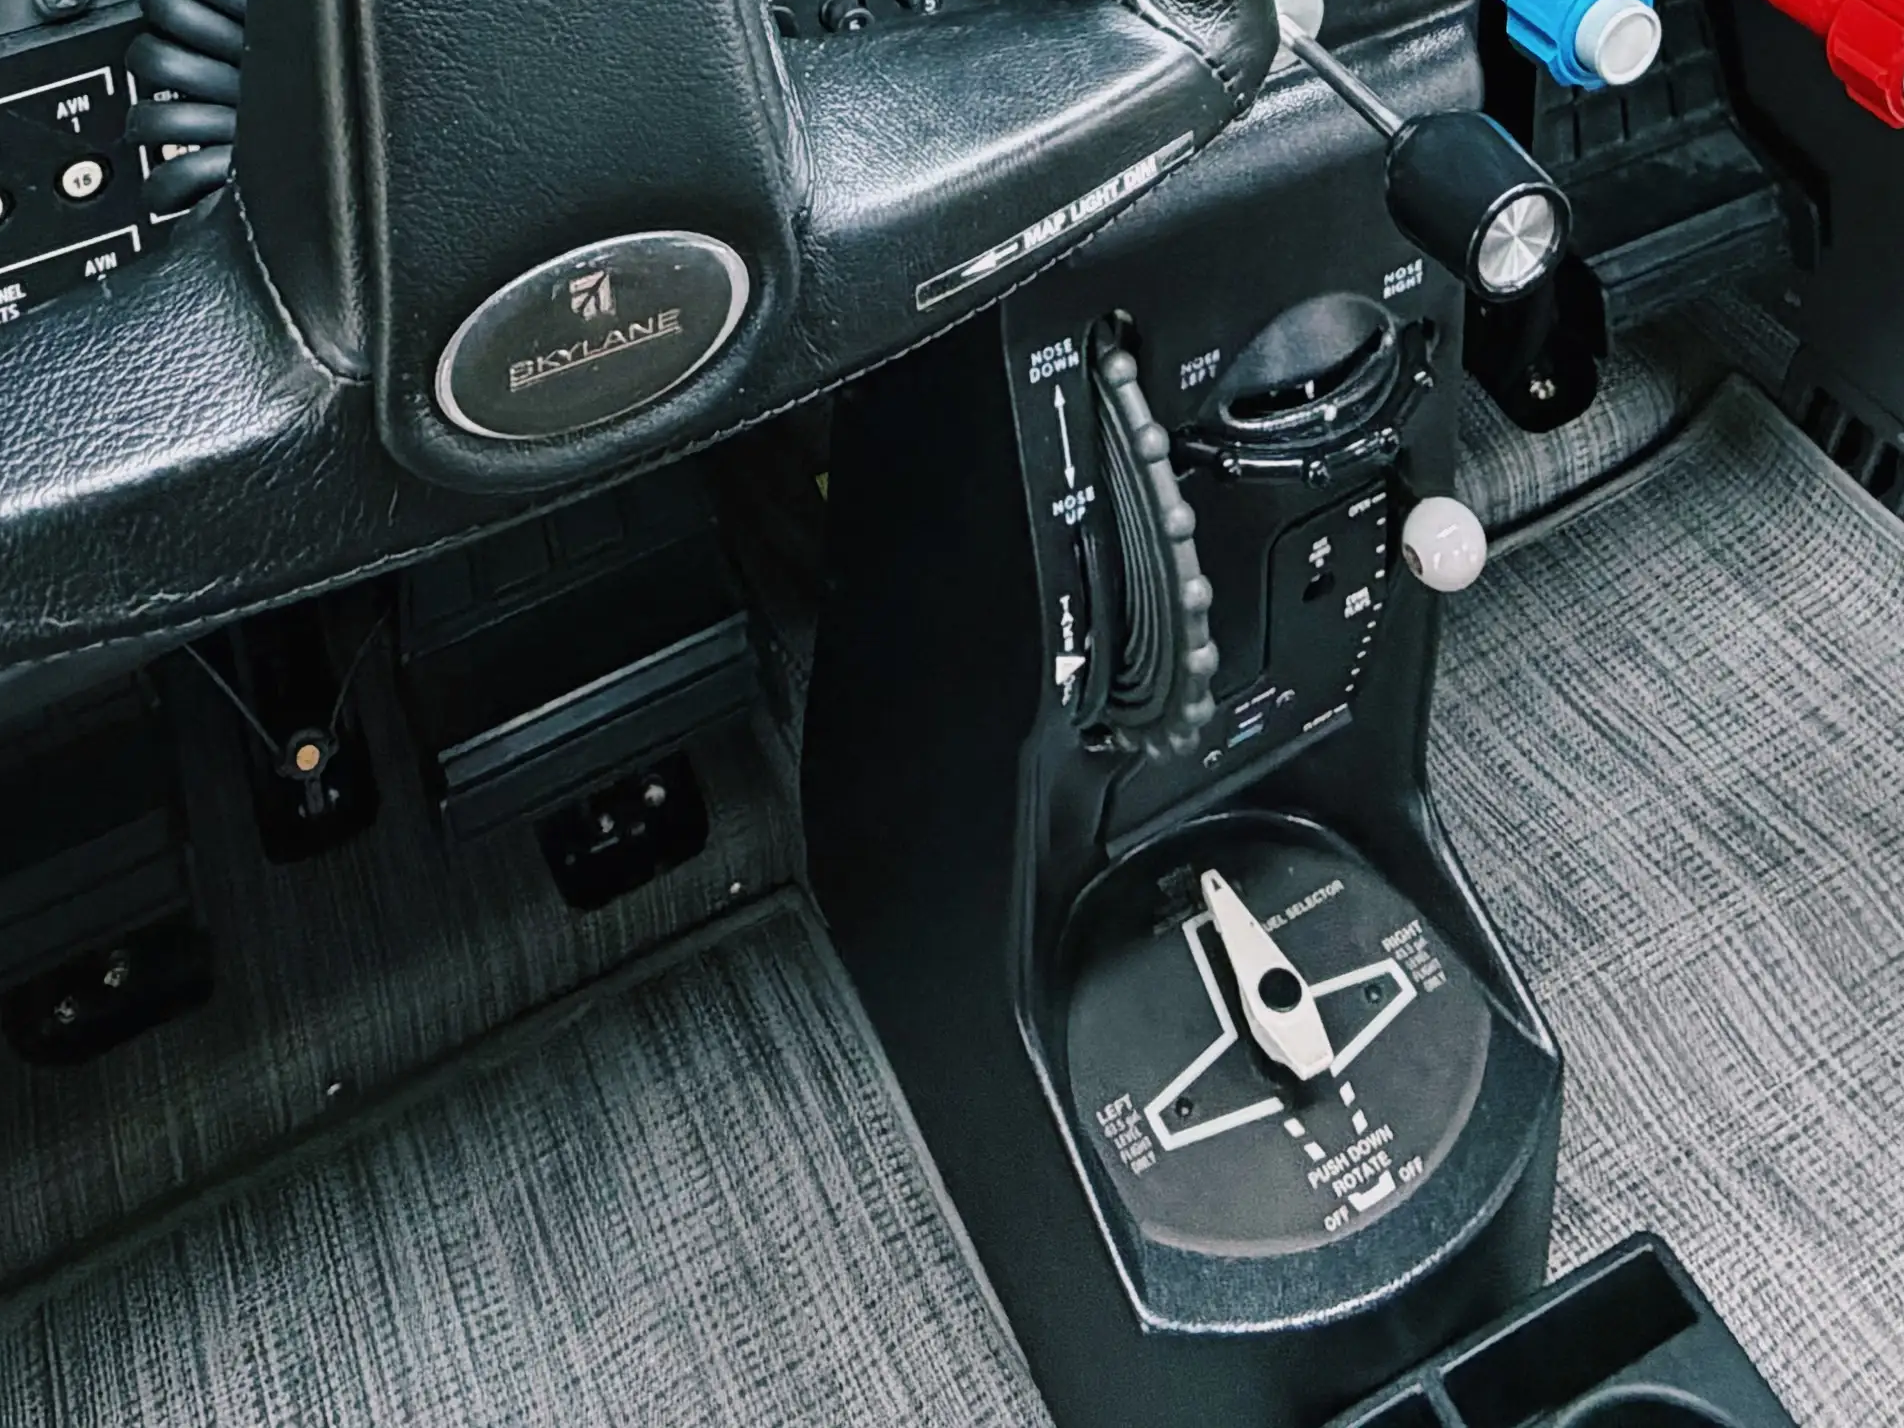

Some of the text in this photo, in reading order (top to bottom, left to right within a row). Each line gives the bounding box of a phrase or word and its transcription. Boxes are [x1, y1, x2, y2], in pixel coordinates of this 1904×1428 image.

[1021, 157, 1160, 249] MAP LIGHT DIM
[509, 308, 682, 383] SKYLANE
[1382, 919, 1423, 952] RIGHT
[1097, 1093, 1134, 1126] LEFT
[1308, 1124, 1394, 1190] PUSH DOWN
[1332, 1150, 1392, 1198] ROTATE
